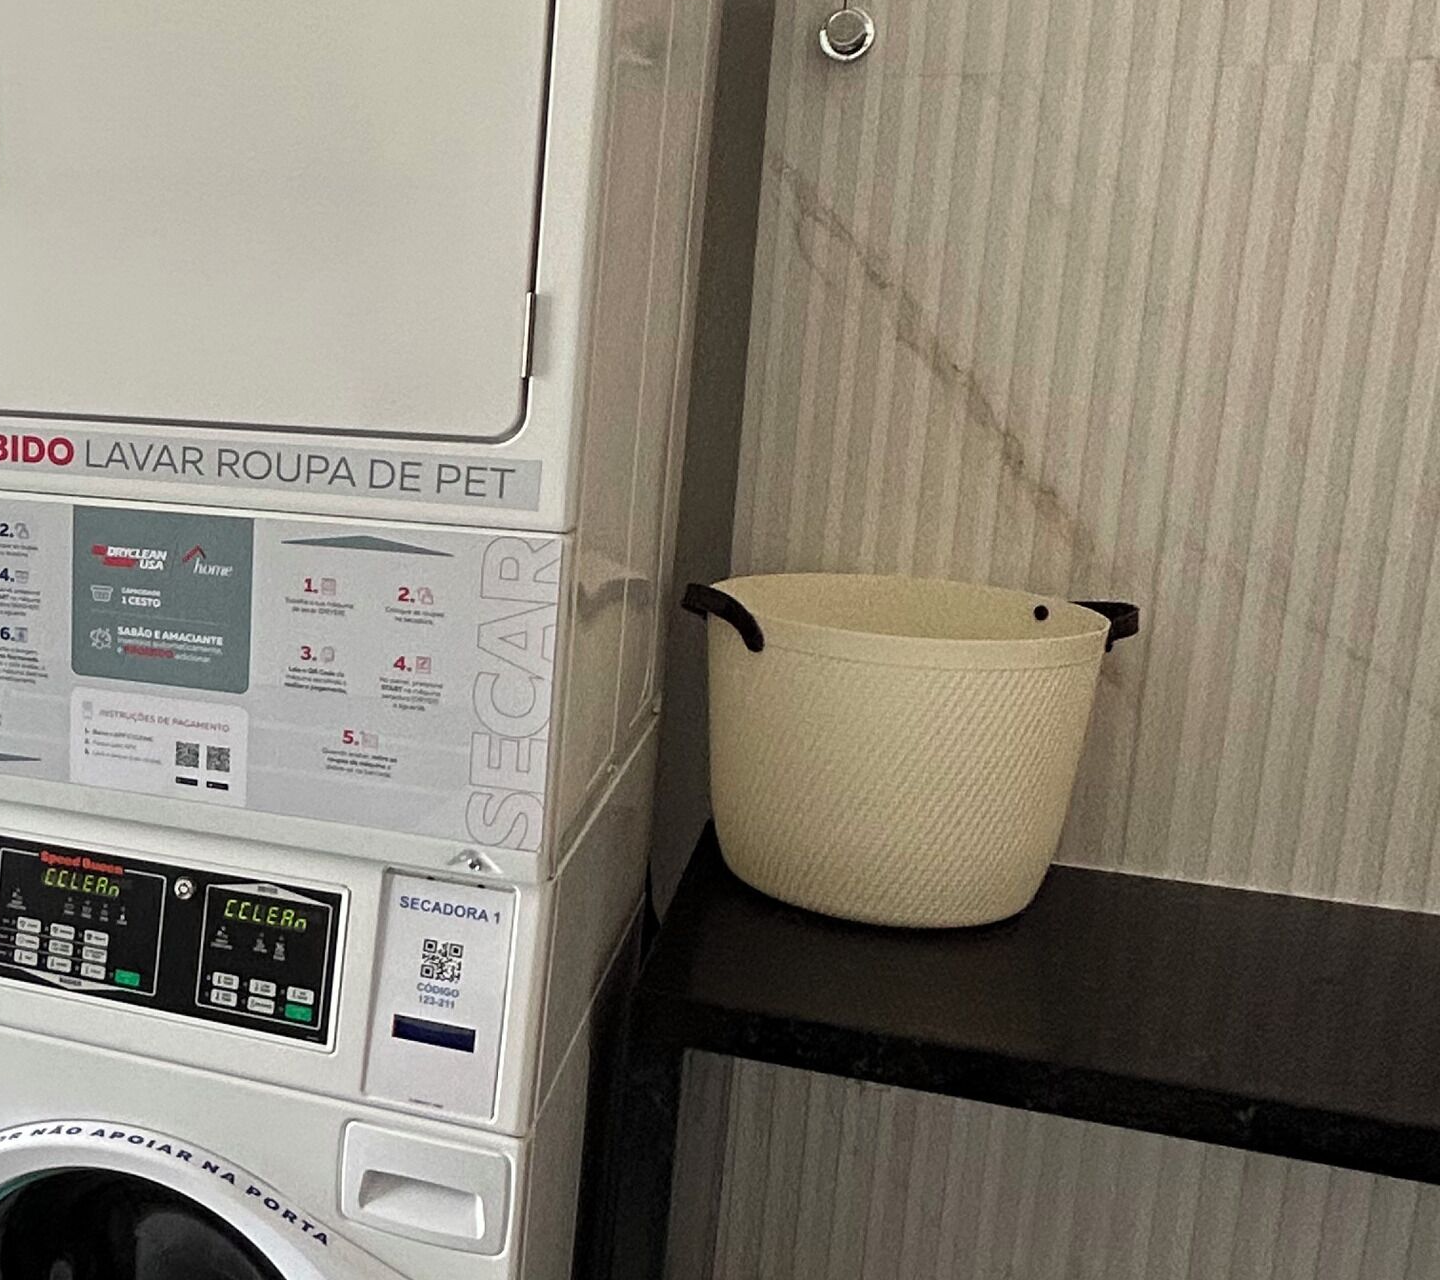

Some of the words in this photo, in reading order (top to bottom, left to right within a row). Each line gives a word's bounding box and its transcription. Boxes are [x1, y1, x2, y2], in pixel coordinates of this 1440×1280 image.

[85, 439, 205, 476] LAVAR
[217, 447, 357, 488] ROUPA
[369, 459, 424, 493] DE
[435, 463, 517, 500] PET
[139, 559, 165, 571] USA
[193, 556, 234, 577] home
[304, 578, 318, 593] 1.
[128, 596, 162, 608] CESTO
[398, 587, 415, 603] 2.
[0, 626, 15, 641] 6.
[117, 626, 153, 639] SABÃO
[154, 630, 161, 640] E
[162, 630, 224, 646] AMACIANTE
[300, 645, 317, 661] 3.
[393, 655, 412, 672] 4.
[465, 535, 560, 852] SECAR
[342, 729, 359, 746] 5.
[399, 895, 490, 923] SECADORA
[494, 911, 501, 925] 1
[416, 982, 461, 999] CÓDIGO
[418, 994, 456, 1010] 123-211
[30, 1124, 83, 1137] NÃO
[90, 1128, 193, 1162] APOIAR
[201, 1160, 236, 1186] NA
[245, 1184, 329, 1246] PORTA
